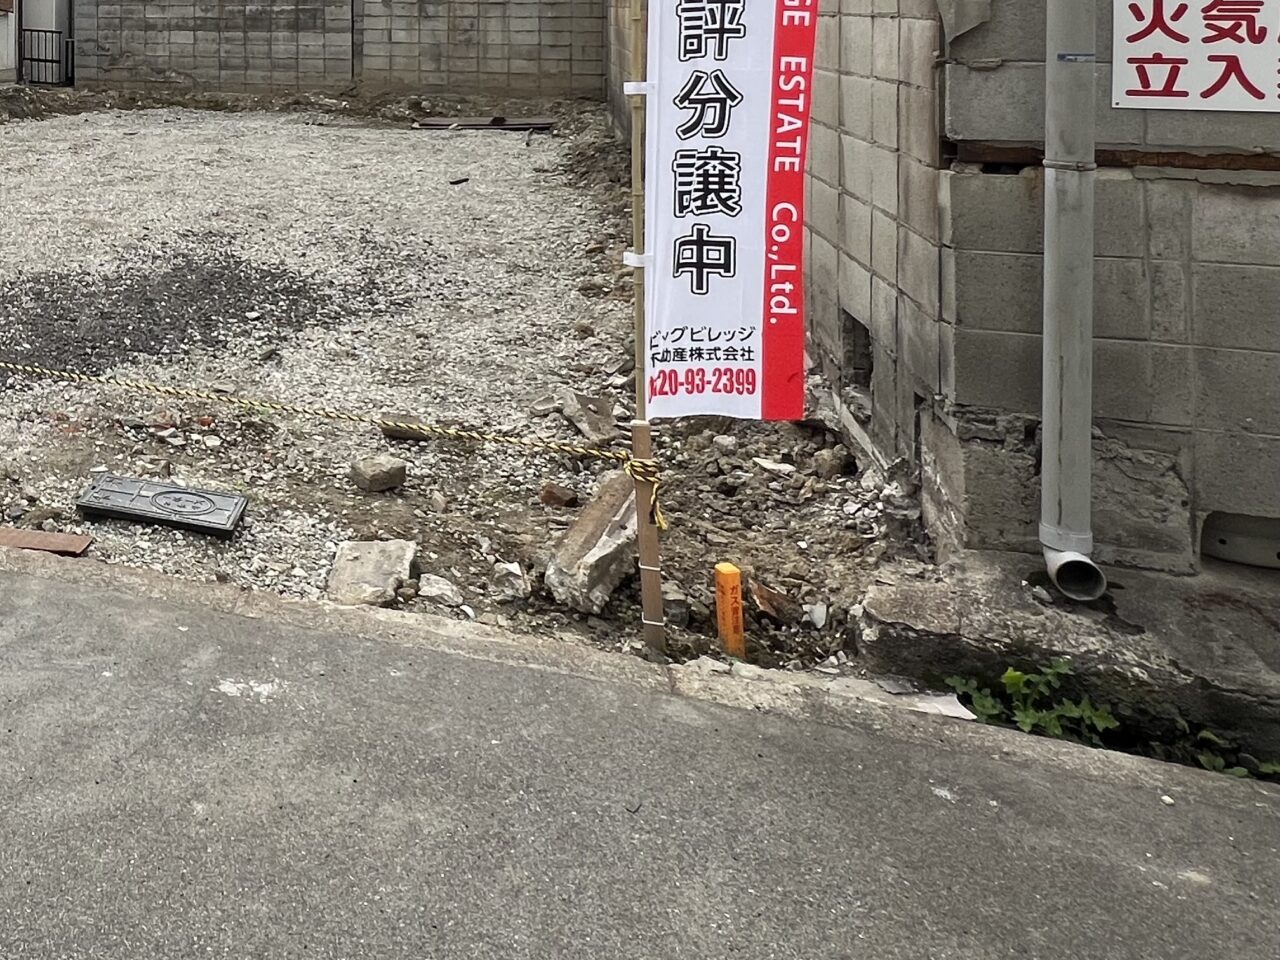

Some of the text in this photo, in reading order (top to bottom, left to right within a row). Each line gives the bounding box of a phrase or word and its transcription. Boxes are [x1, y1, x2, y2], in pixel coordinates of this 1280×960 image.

[774, 56, 807, 172] ESTATE
[1125, 52, 1280, 100] 立入
[768, 203, 798, 324] Co.,Ltd.
[649, 368, 756, 404] 20-93-2399
